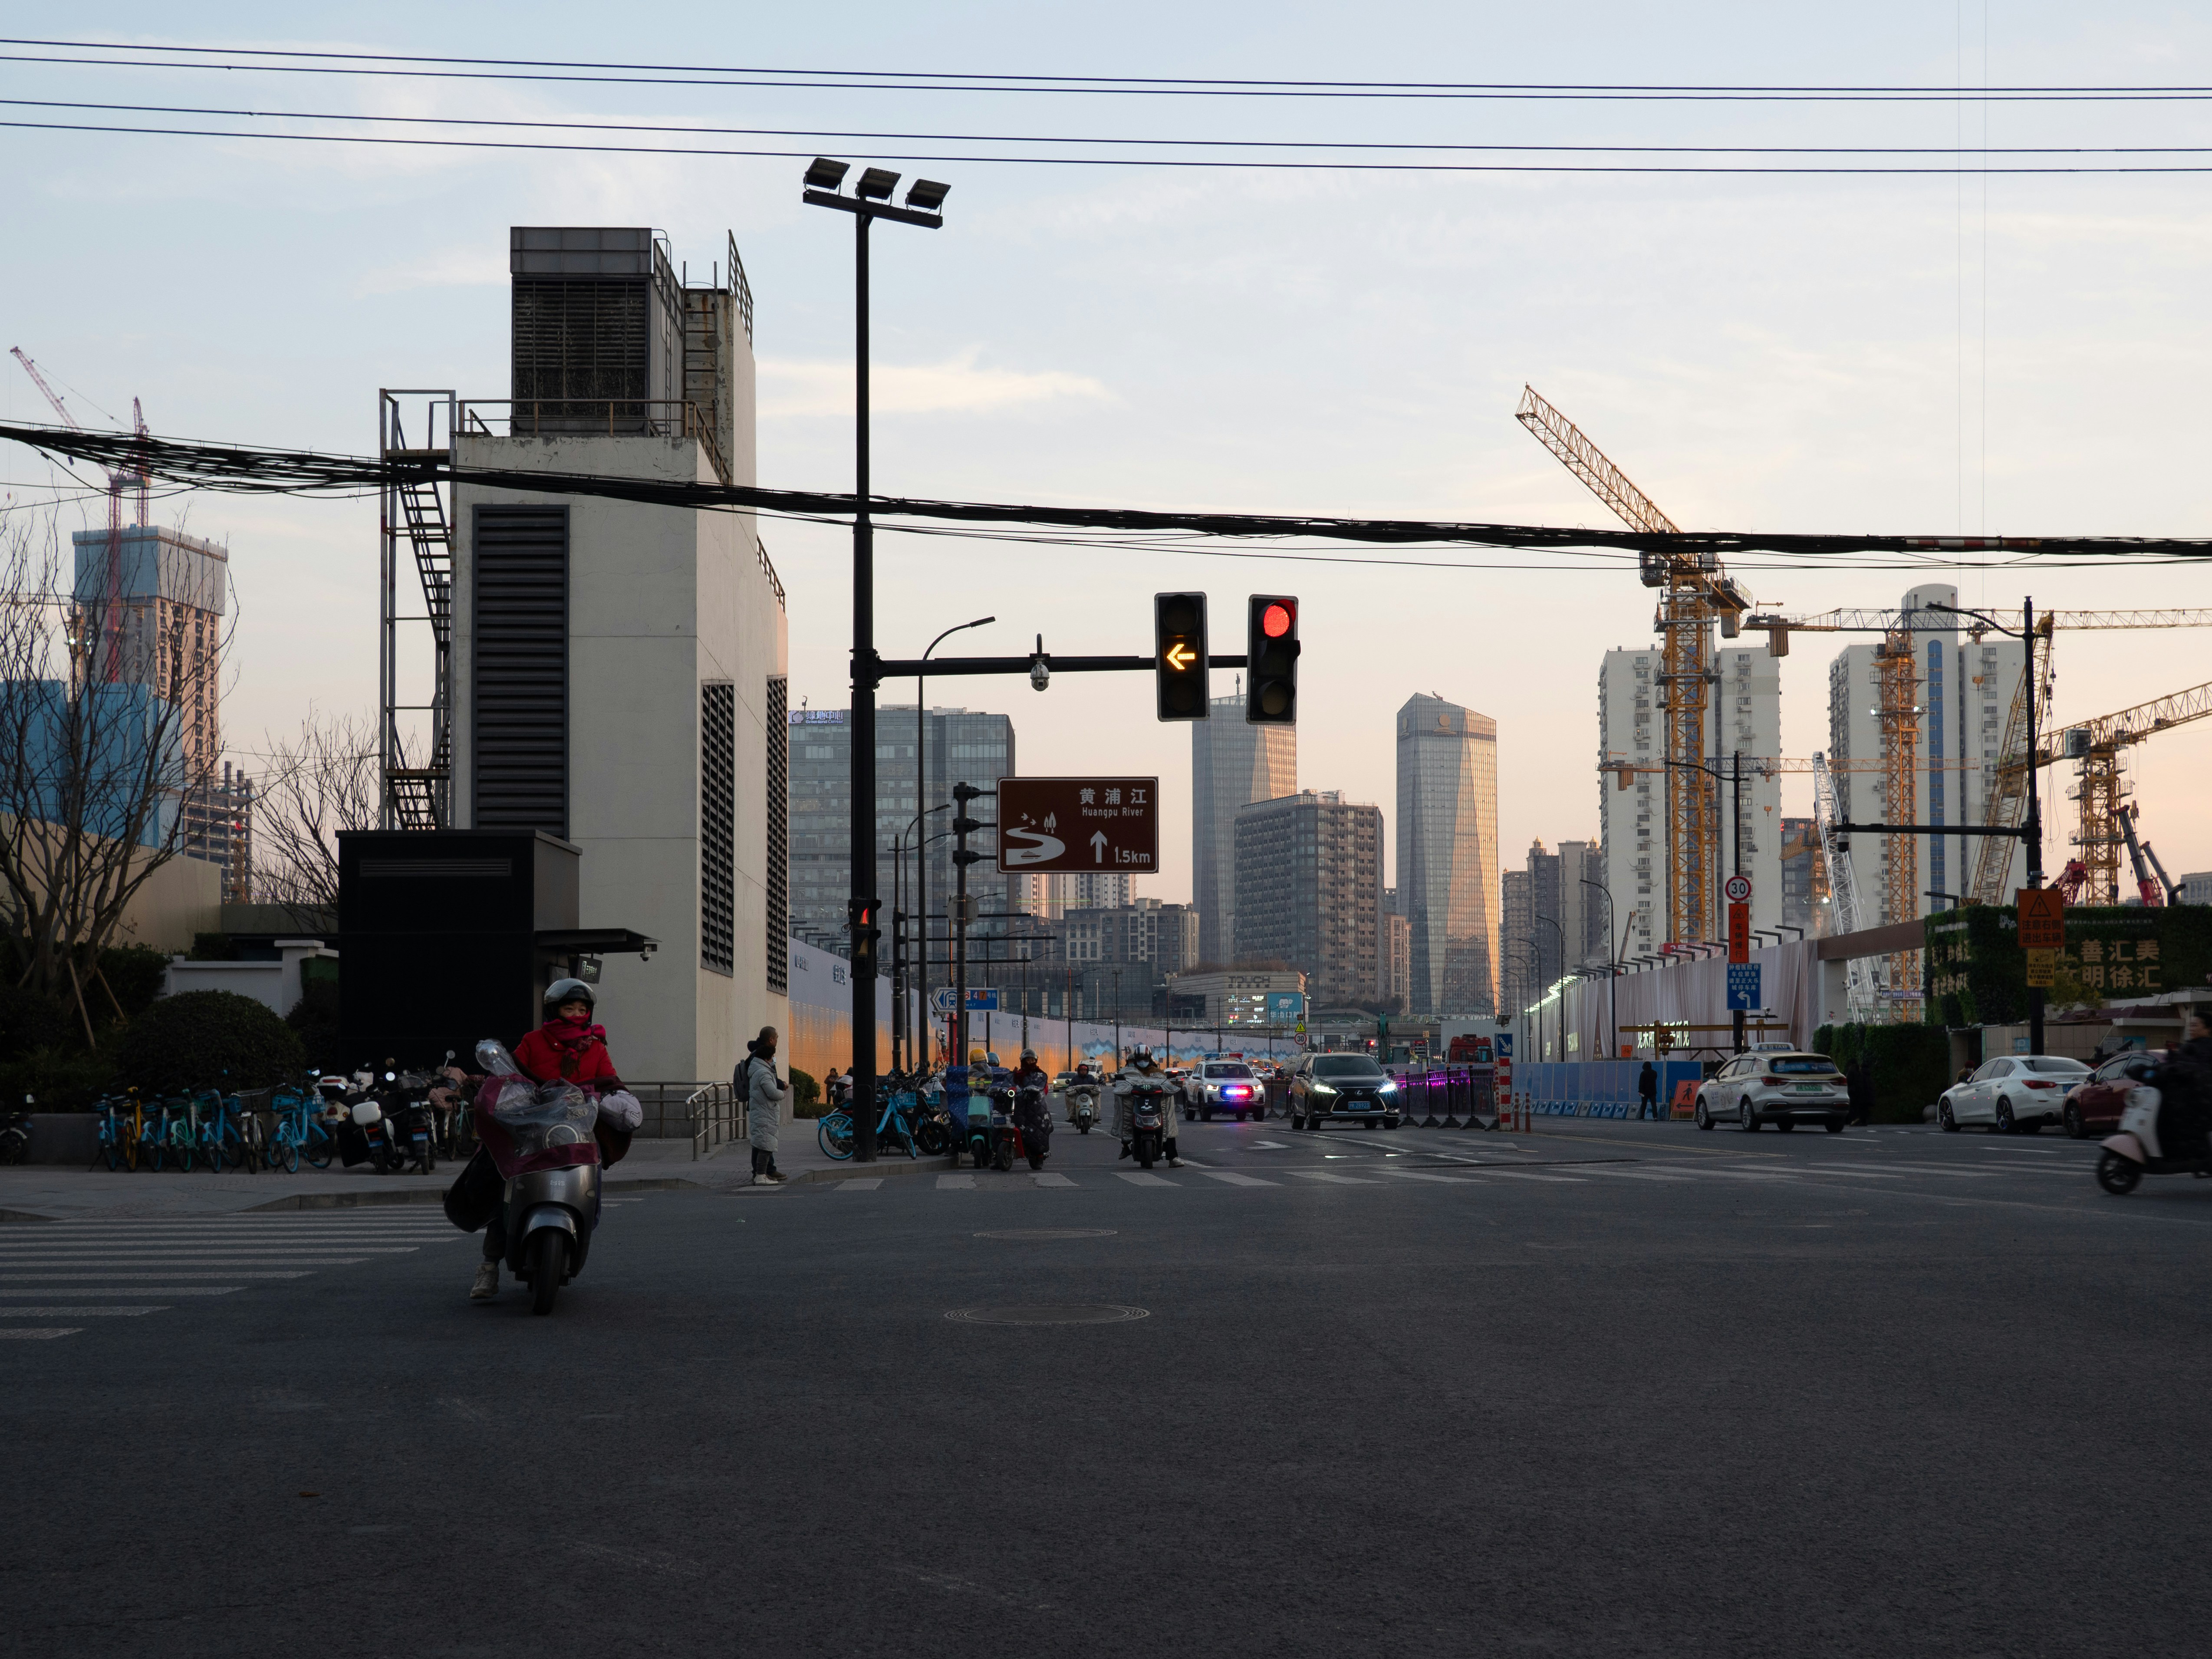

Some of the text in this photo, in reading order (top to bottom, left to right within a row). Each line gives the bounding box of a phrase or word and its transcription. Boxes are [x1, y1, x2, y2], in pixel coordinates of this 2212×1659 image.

[805, 711, 844, 720] 绿地中心
[1080, 788, 1147, 804] 黄浦江
[1082, 807, 1143, 819] Huangpu River
[1115, 846, 1150, 863] 1.5km
[1731, 882, 1746, 895] 30
[2022, 919, 2061, 930] 注意右侧
[2022, 932, 2061, 943] 进出车辆
[973, 991, 978, 1000] 4
[980, 991, 986, 1000] 7
